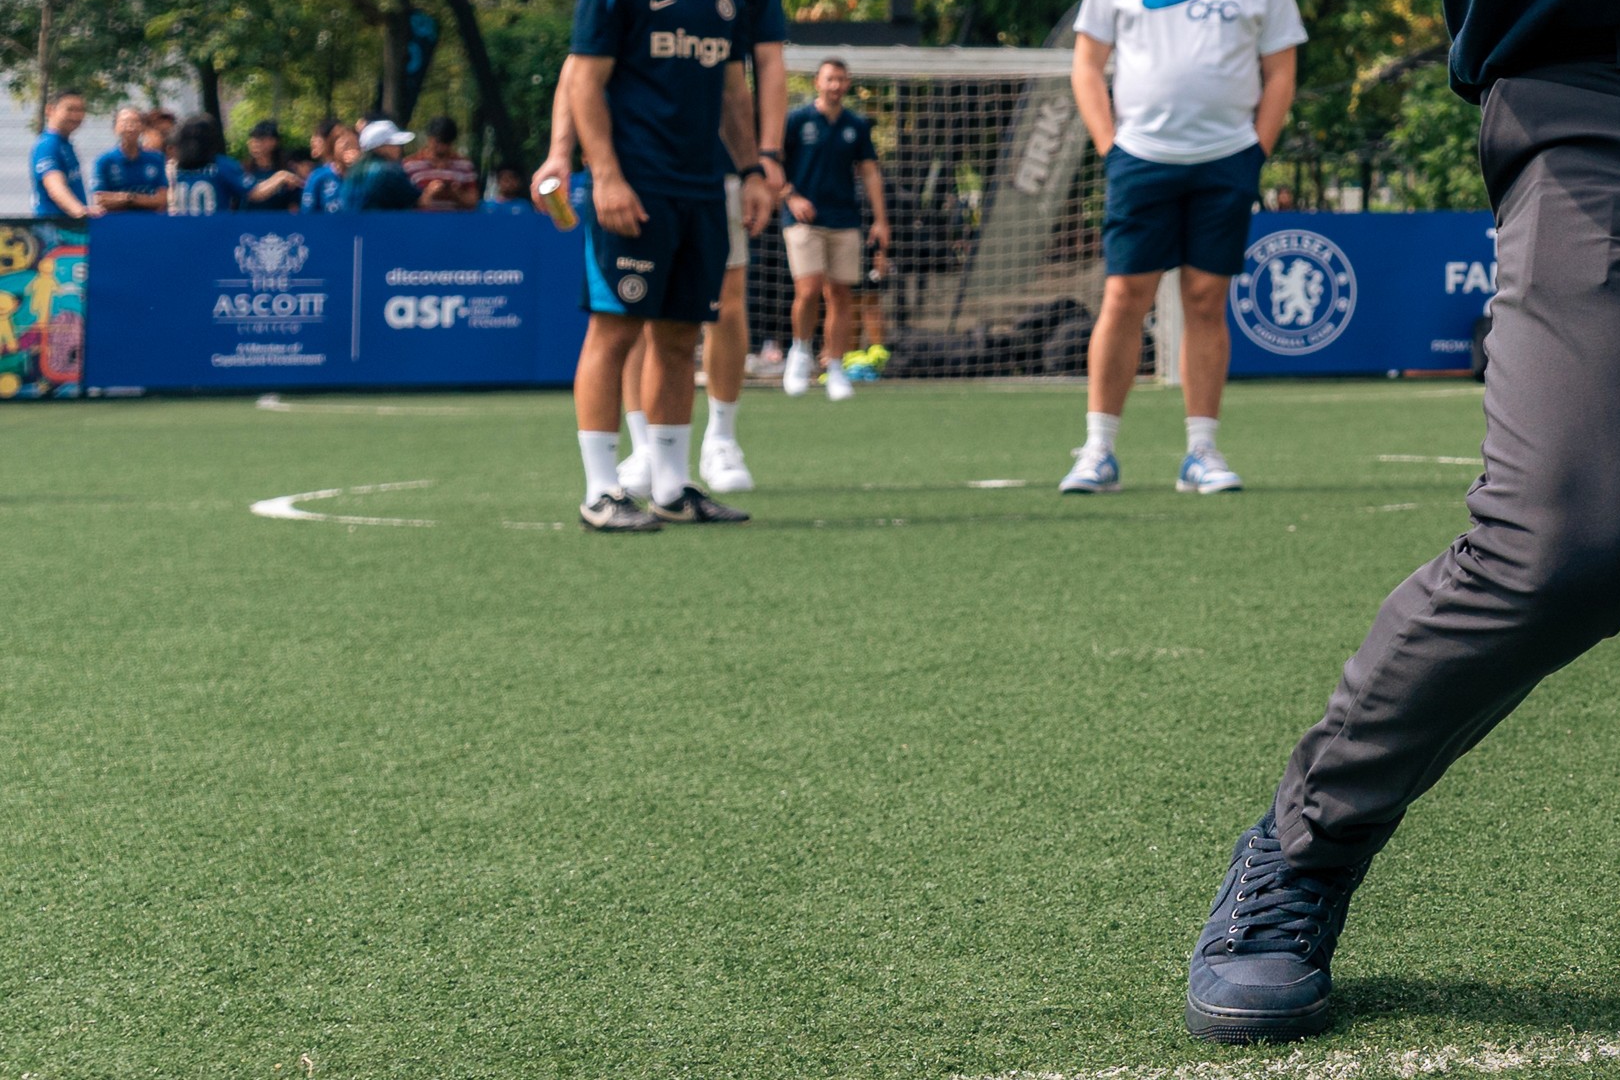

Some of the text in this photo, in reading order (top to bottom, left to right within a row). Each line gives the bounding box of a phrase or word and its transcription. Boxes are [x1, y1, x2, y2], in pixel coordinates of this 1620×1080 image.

[1186, 0, 1241, 23] CFC
[1252, 235, 1334, 264] CHELSEA
[212, 293, 328, 318] ASCOTT
[384, 294, 466, 330] asr
